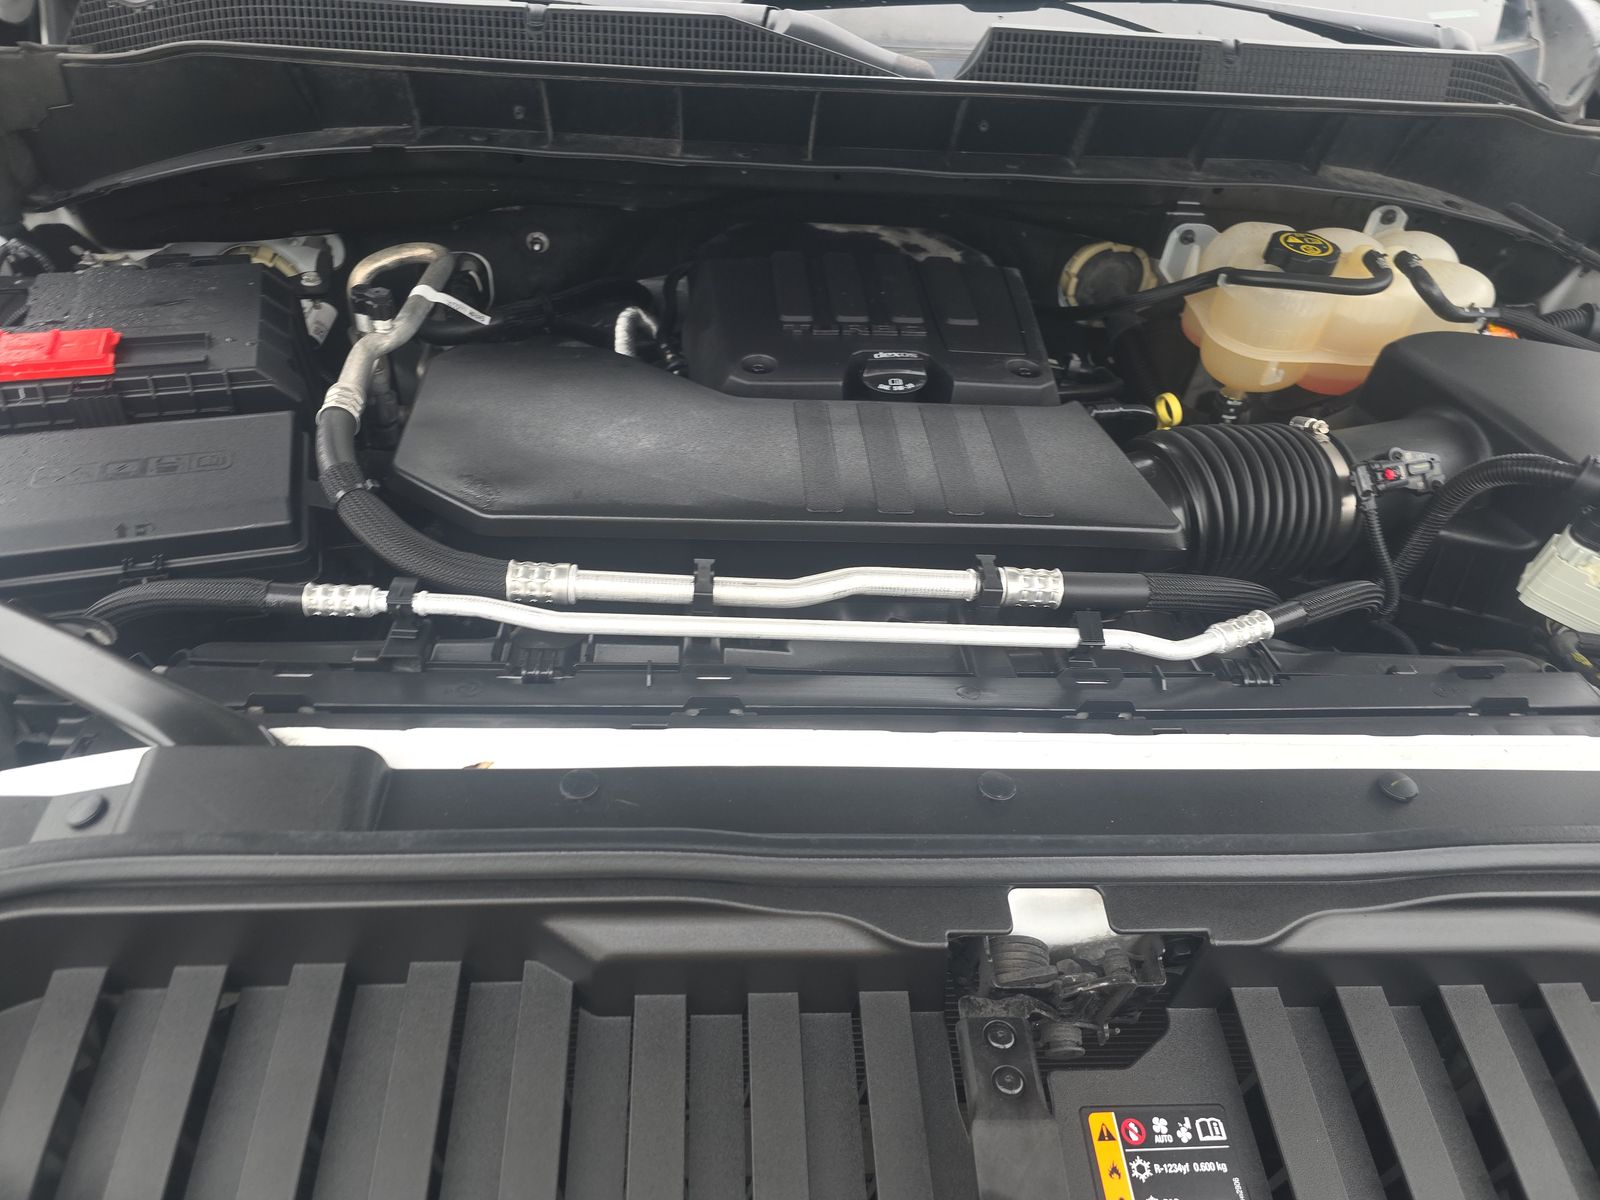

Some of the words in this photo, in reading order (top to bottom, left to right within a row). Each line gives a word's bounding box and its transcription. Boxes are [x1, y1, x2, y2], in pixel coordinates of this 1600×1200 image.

[1155, 1134, 1173, 1144] AUTO
[1153, 1163, 1190, 1175] R-1234yf
[1192, 1161, 1216, 1173] 0.600
[1215, 1161, 1228, 1173] kg
